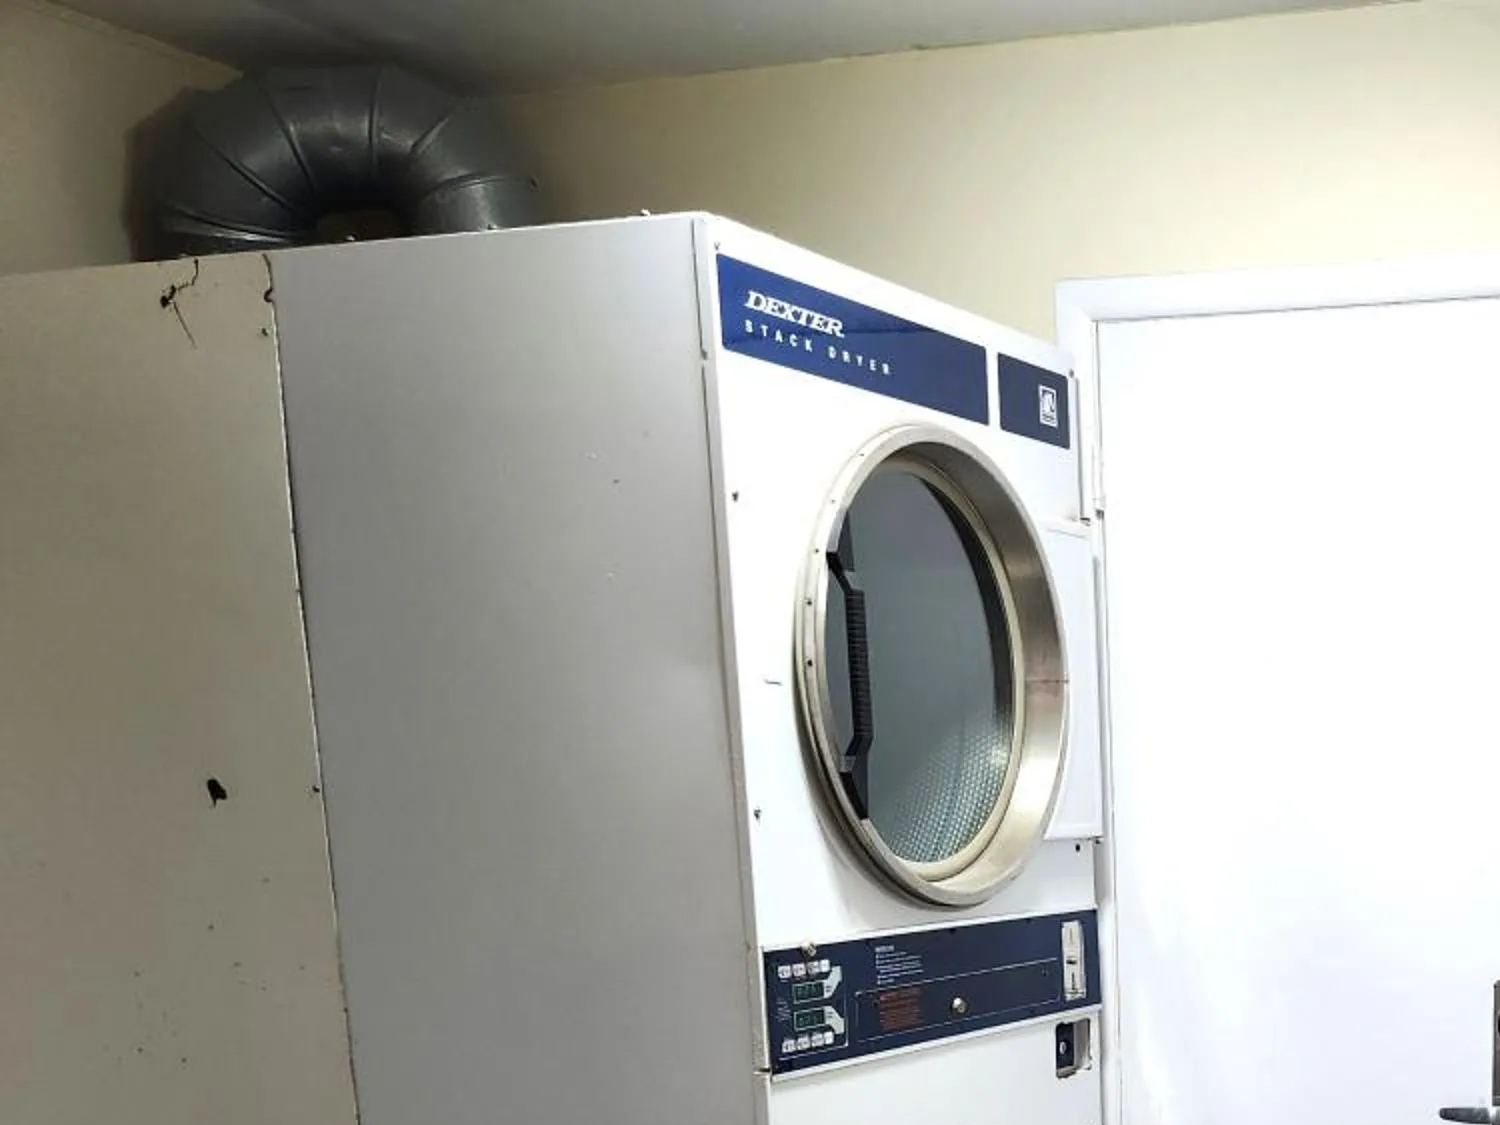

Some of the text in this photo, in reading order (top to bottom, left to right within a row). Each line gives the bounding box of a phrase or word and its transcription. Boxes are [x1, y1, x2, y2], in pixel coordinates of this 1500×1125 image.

[745, 291, 844, 337] DEXTER
[745, 319, 890, 375] STACK DRYER
